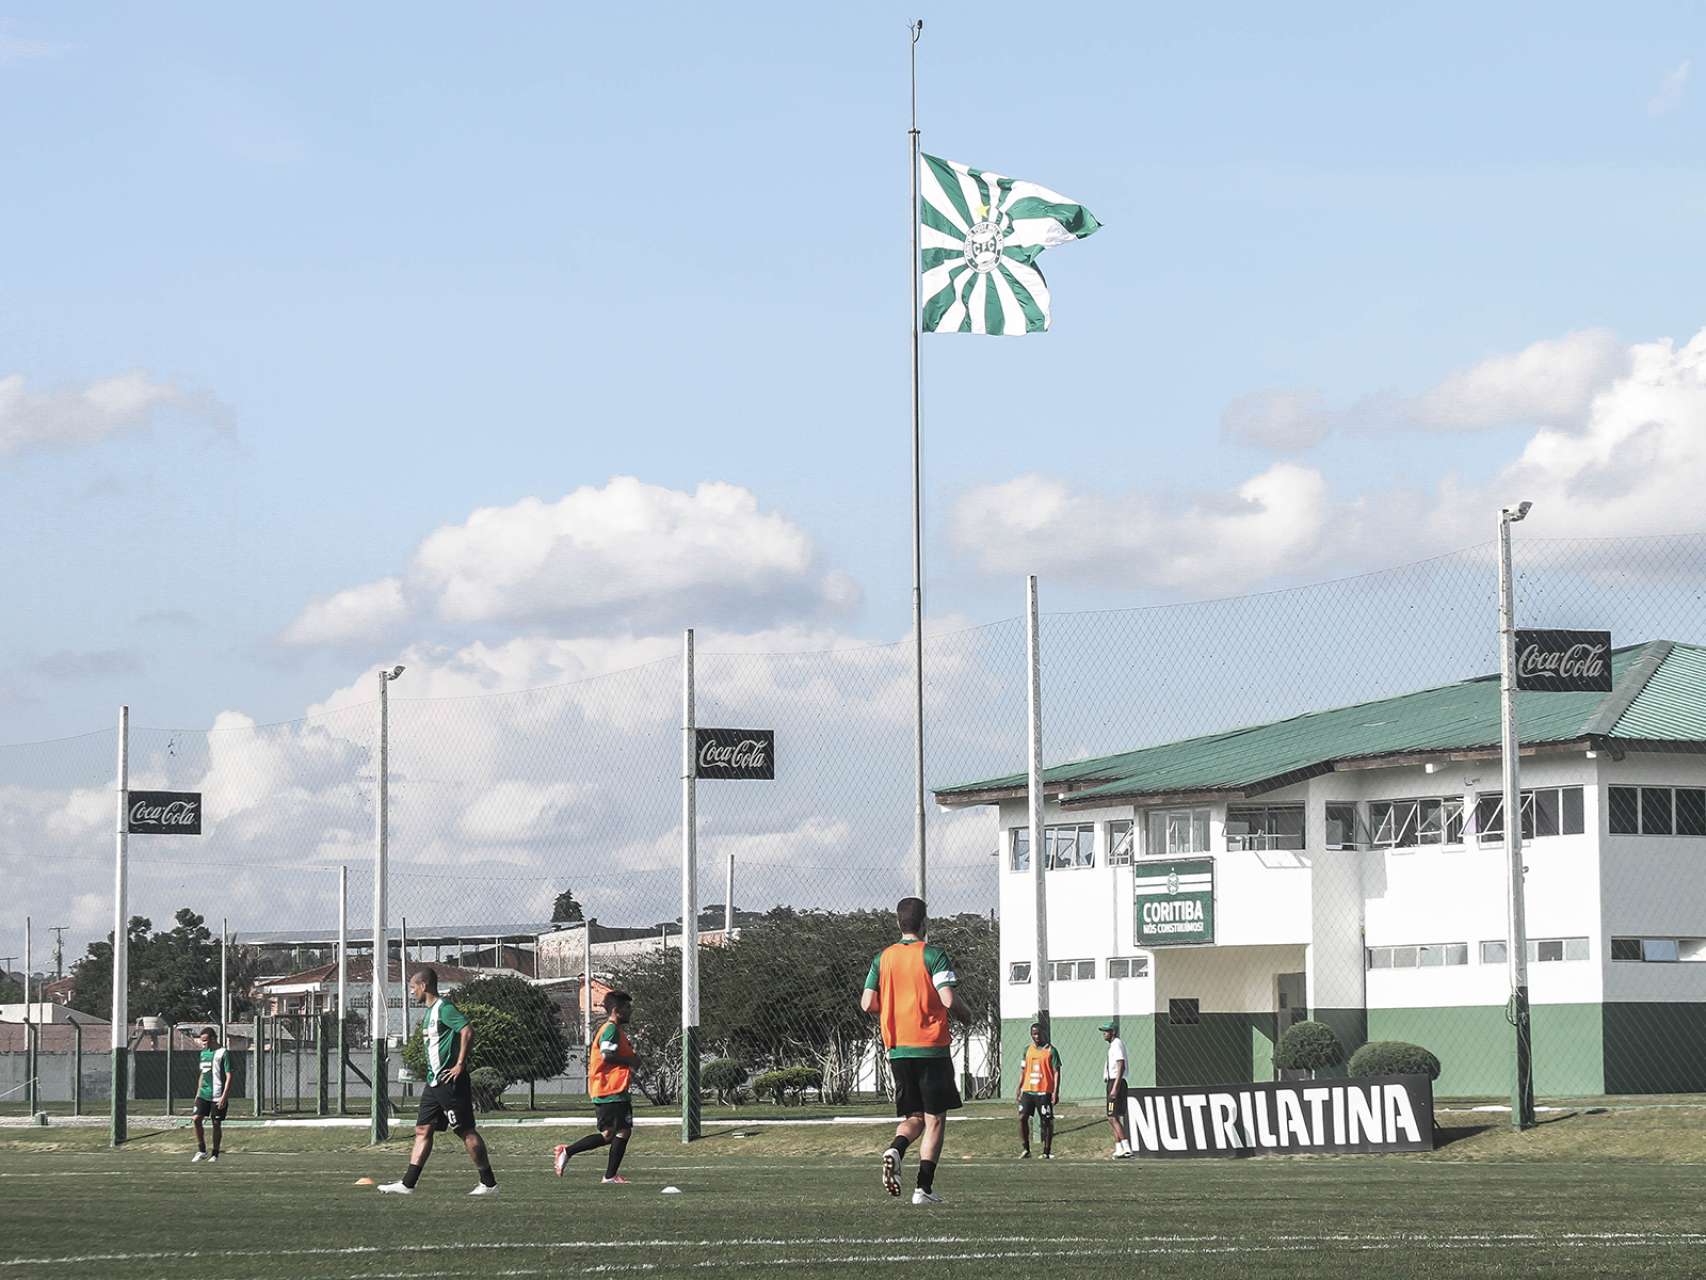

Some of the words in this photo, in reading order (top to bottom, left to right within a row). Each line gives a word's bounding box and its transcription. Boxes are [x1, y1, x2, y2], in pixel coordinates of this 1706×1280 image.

[1518, 643, 1608, 678] Coca-Cola
[699, 739, 769, 769] Coca-Cola
[129, 800, 199, 825] Coca-Cola
[1143, 900, 1204, 922] CORITIBA
[1127, 1084, 1422, 1151] NUTRILATINA
